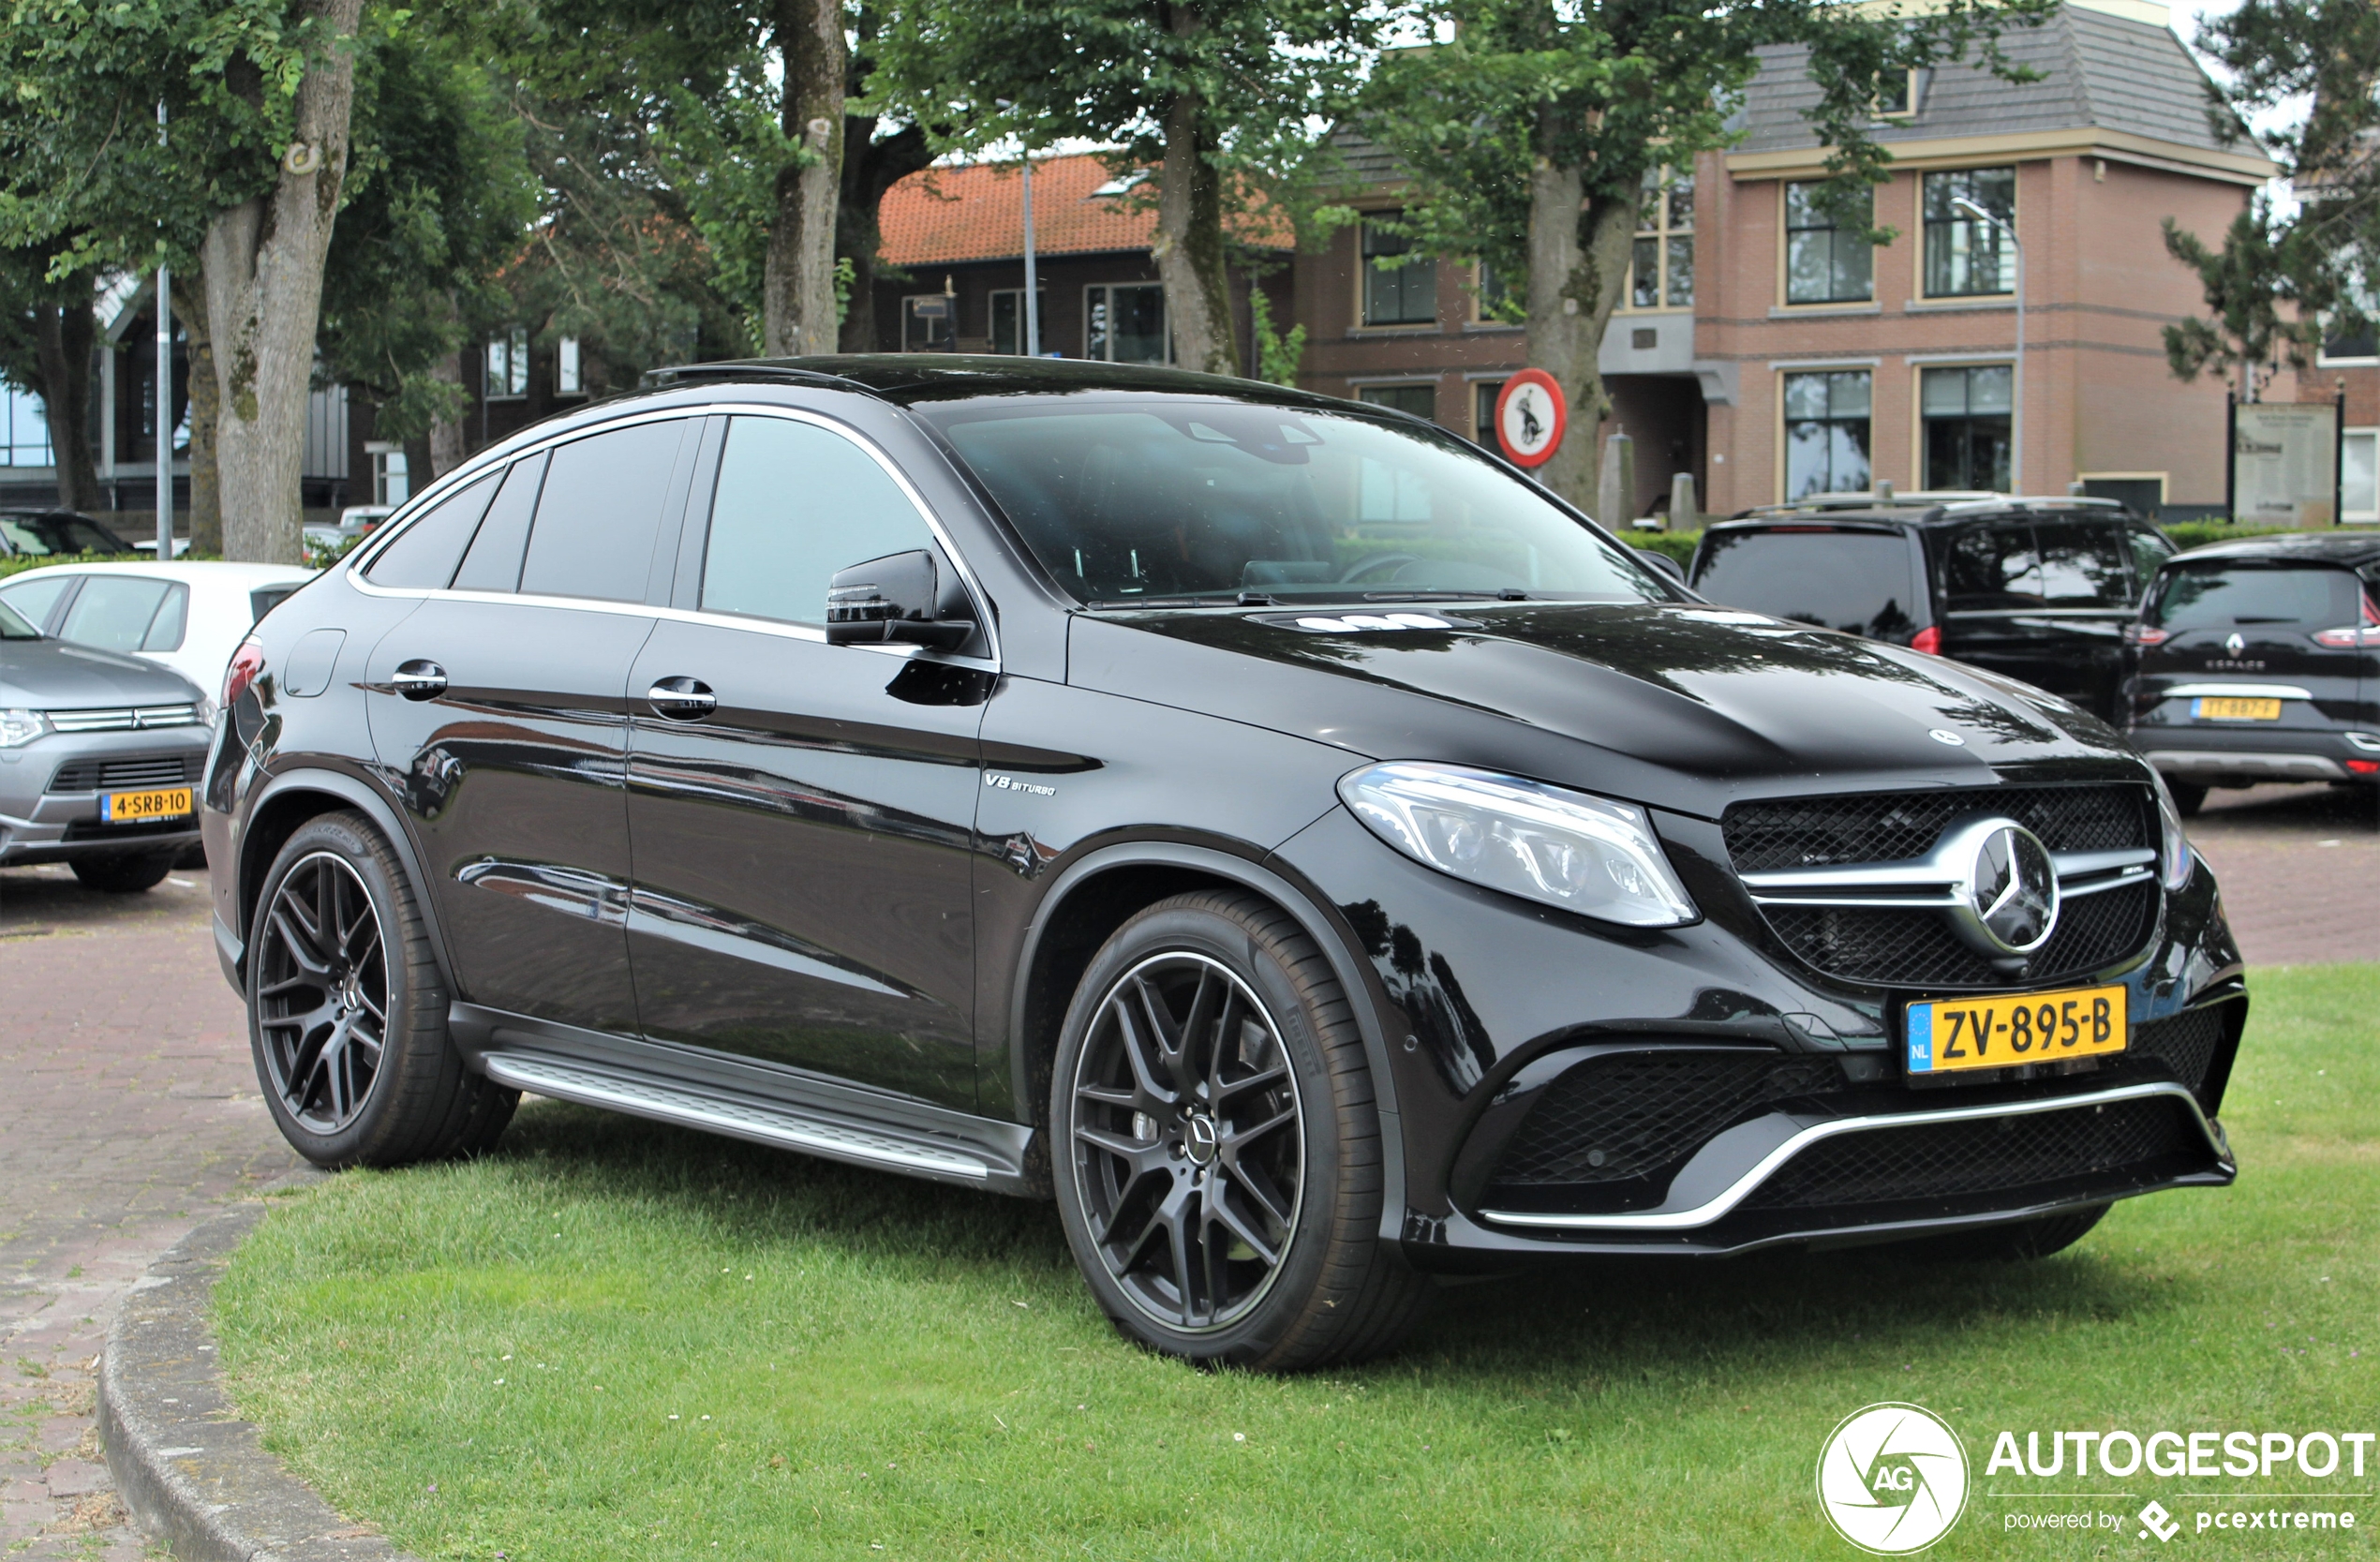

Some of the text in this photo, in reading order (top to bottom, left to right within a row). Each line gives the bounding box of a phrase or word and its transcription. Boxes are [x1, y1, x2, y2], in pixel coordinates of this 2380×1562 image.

[986, 774, 1056, 796] V8 BITURBO
[117, 793, 185, 815] 4-SRB-10
[1942, 997, 2111, 1059] ZV-895-B
[1911, 1045, 1928, 1060] NL
